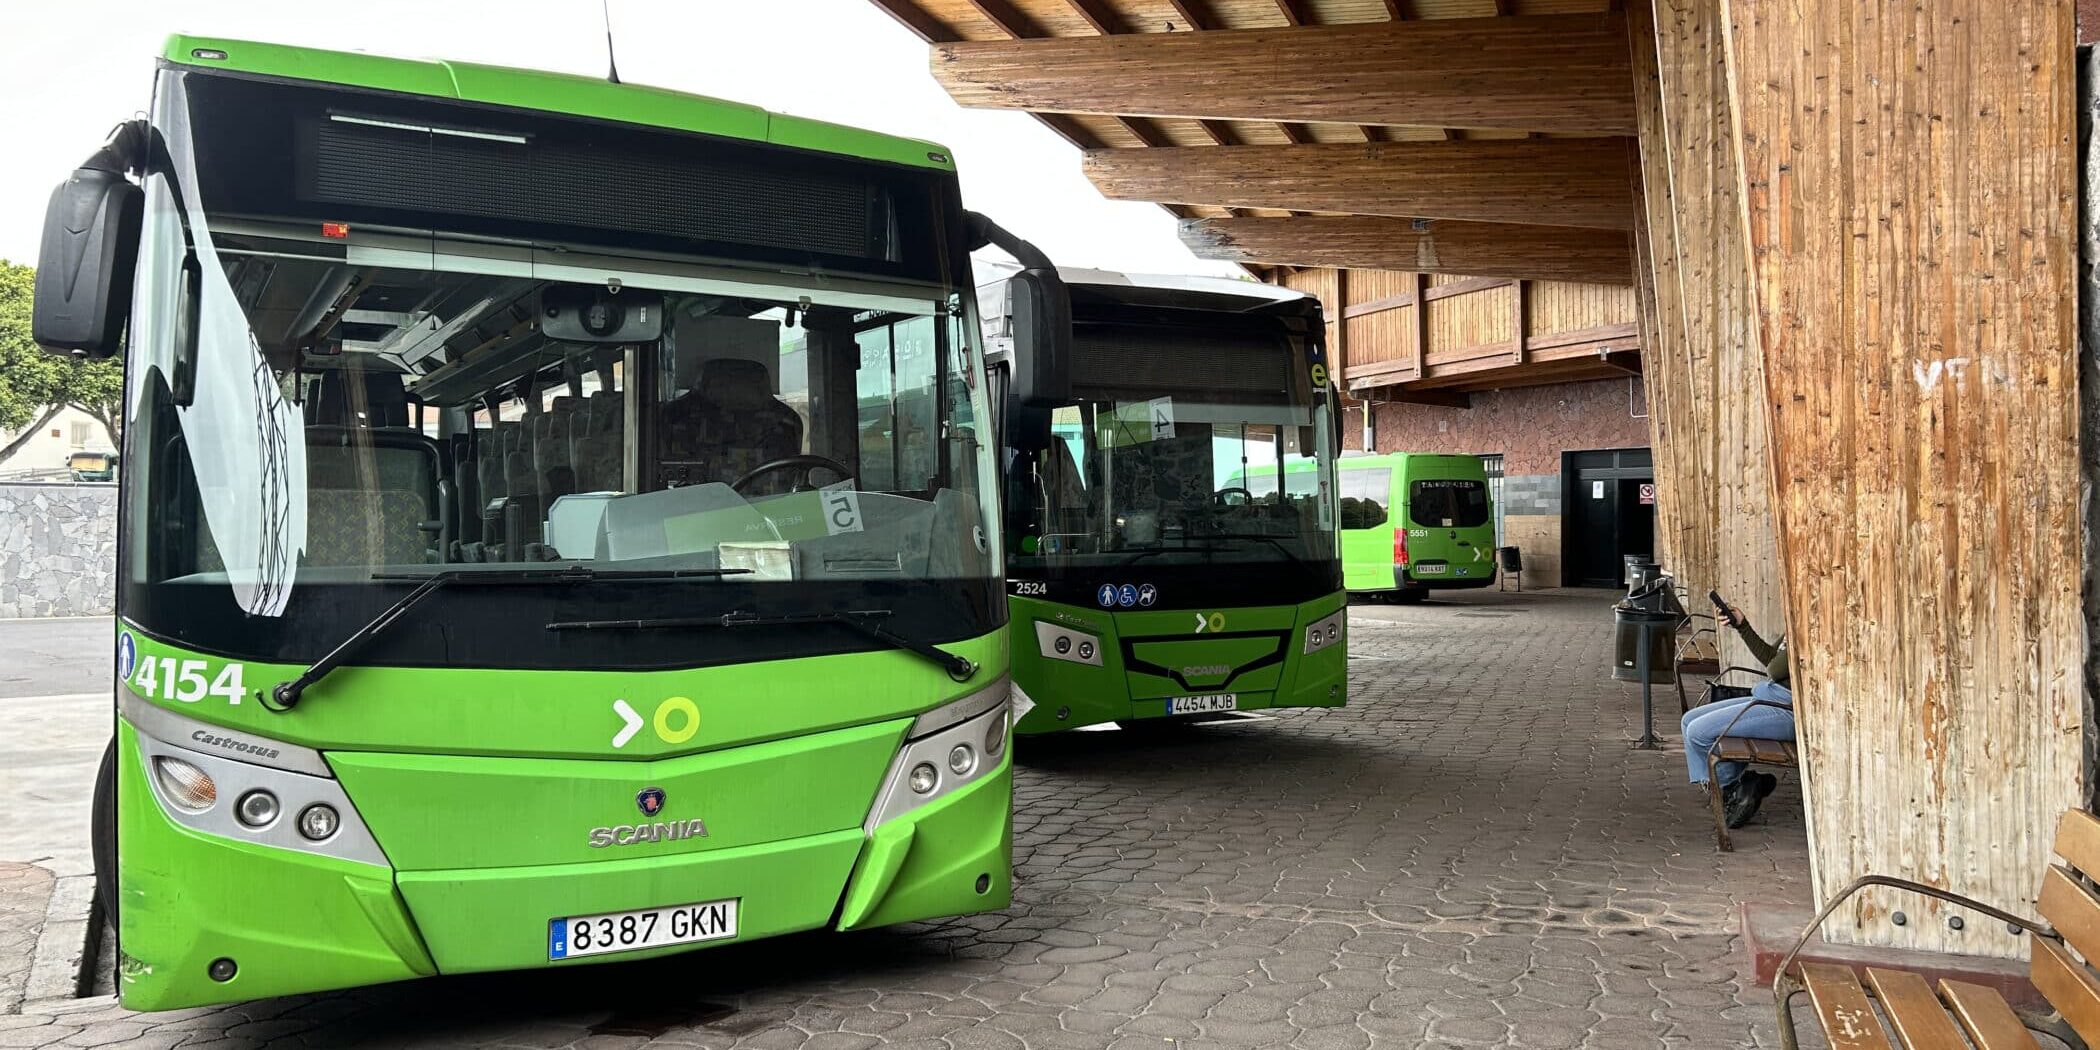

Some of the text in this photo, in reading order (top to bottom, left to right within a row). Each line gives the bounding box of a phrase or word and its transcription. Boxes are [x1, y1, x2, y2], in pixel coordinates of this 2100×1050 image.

[1409, 529, 1429, 538] 5551
[1016, 582, 1047, 595] 2524
[135, 655, 247, 705] 4154
[1183, 664, 1232, 677] SCANIA
[1175, 694, 1233, 713] 4454 MJB
[191, 730, 280, 759] Castrosua
[588, 818, 709, 848] SCANIA
[573, 904, 728, 950] 8387 GKN
[555, 941, 563, 951] E
